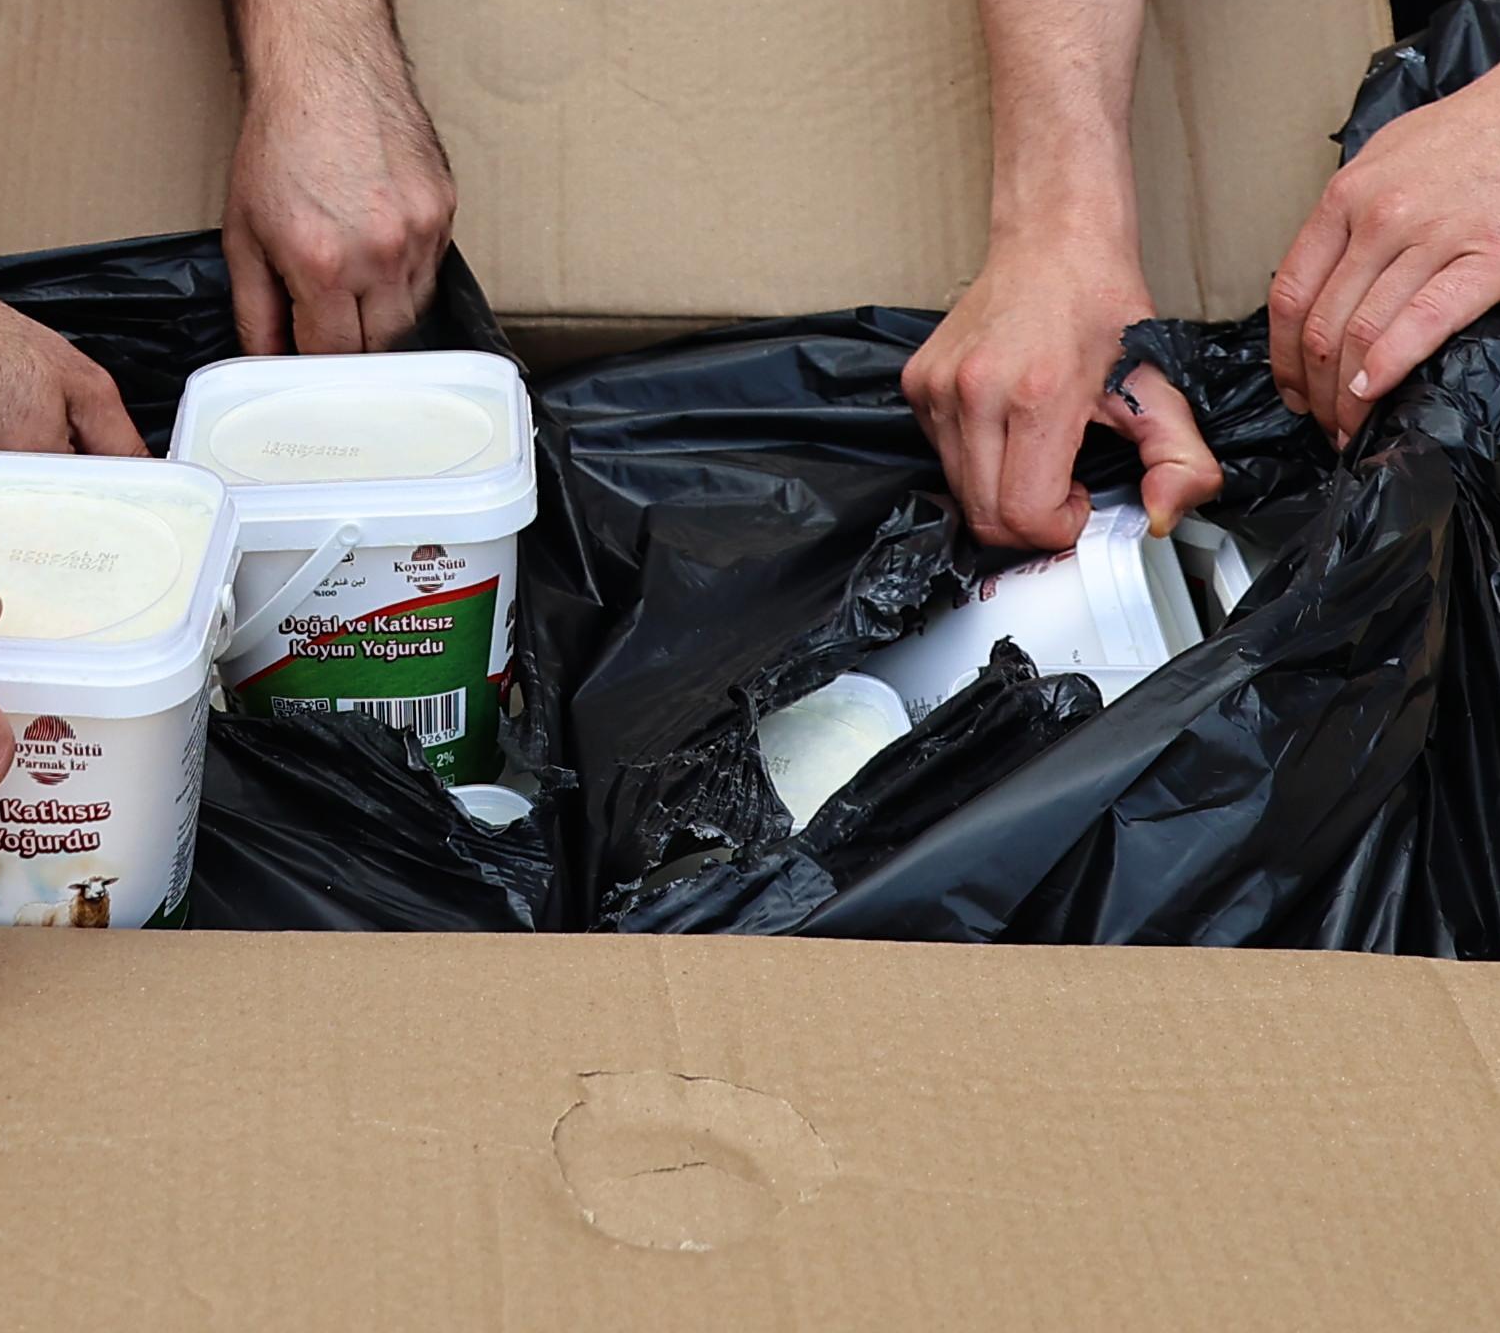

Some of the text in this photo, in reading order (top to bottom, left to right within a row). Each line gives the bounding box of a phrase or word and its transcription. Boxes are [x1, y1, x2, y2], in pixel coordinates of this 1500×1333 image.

[393, 556, 467, 575] Koyun Sütü
[405, 571, 456, 584] Parmak İzi
[278, 613, 454, 635] Doğal ve Katkısız
[289, 638, 446, 662] Koyun Yoğurdu
[13, 739, 104, 758] oyun Sütü
[15, 756, 88, 772] Parmak İzi
[0, 796, 113, 825] Katkısız
